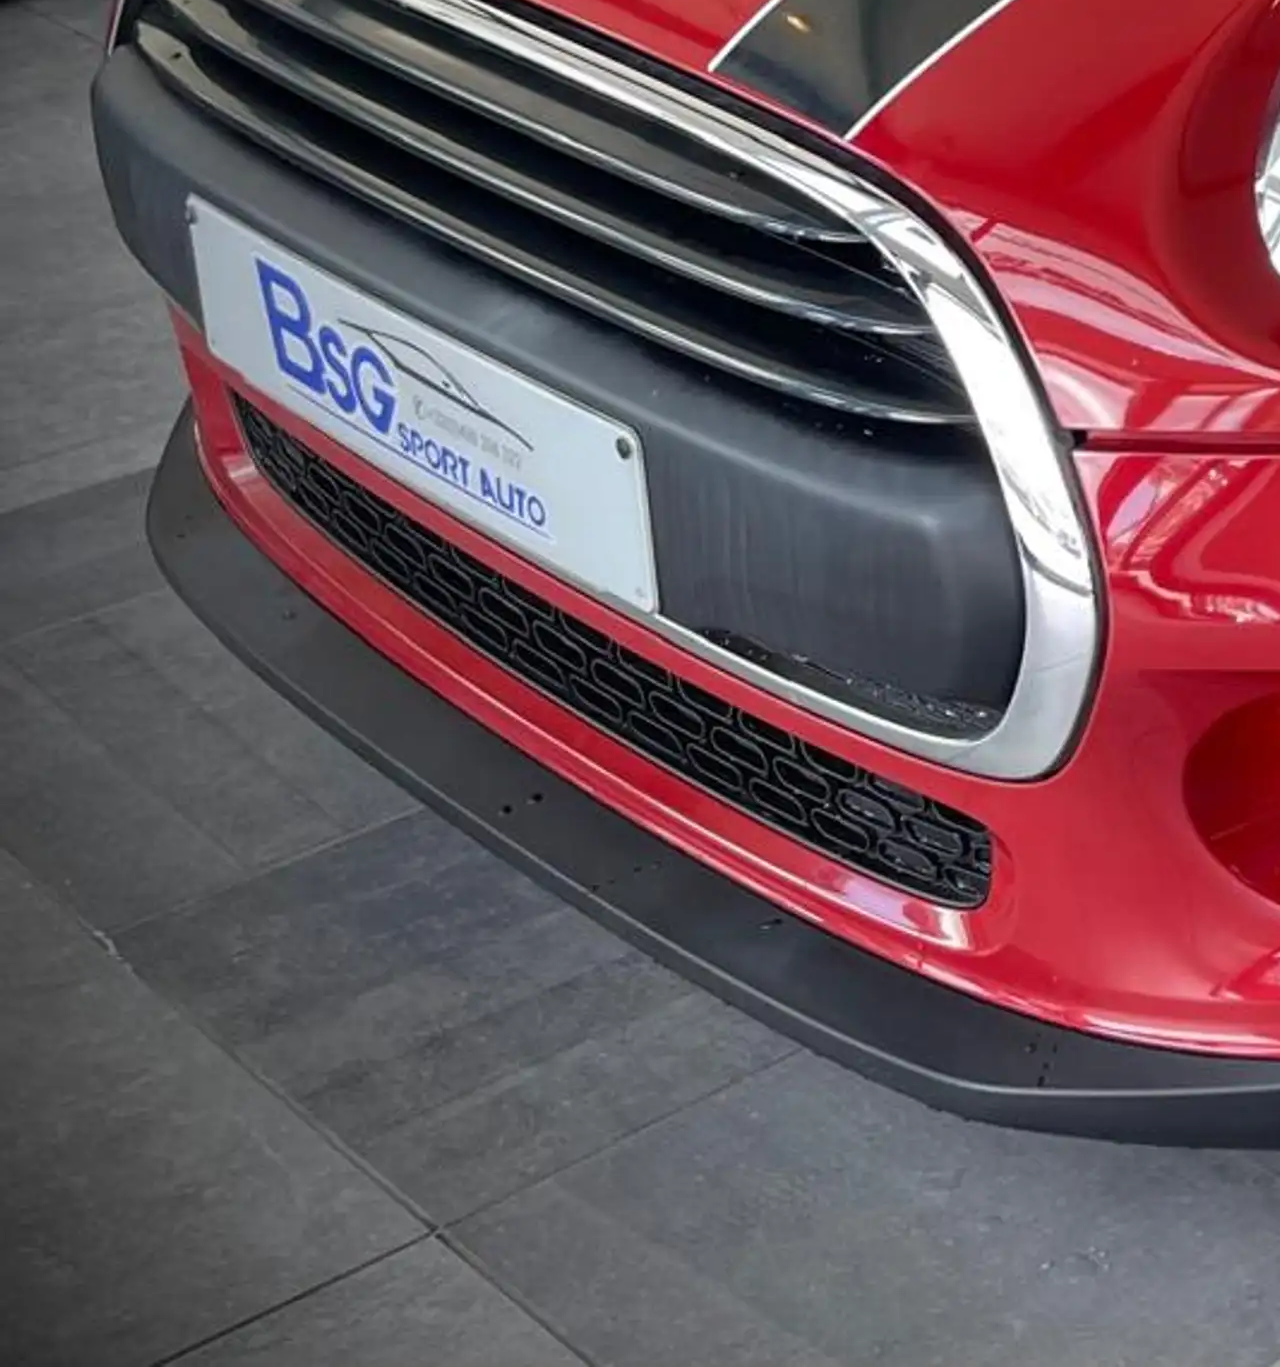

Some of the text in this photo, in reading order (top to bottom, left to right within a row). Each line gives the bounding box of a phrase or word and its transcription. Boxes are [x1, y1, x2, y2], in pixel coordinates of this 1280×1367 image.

[255, 258, 398, 435] BSG
[398, 422, 470, 486] SPORT
[480, 467, 546, 527] AUTO
